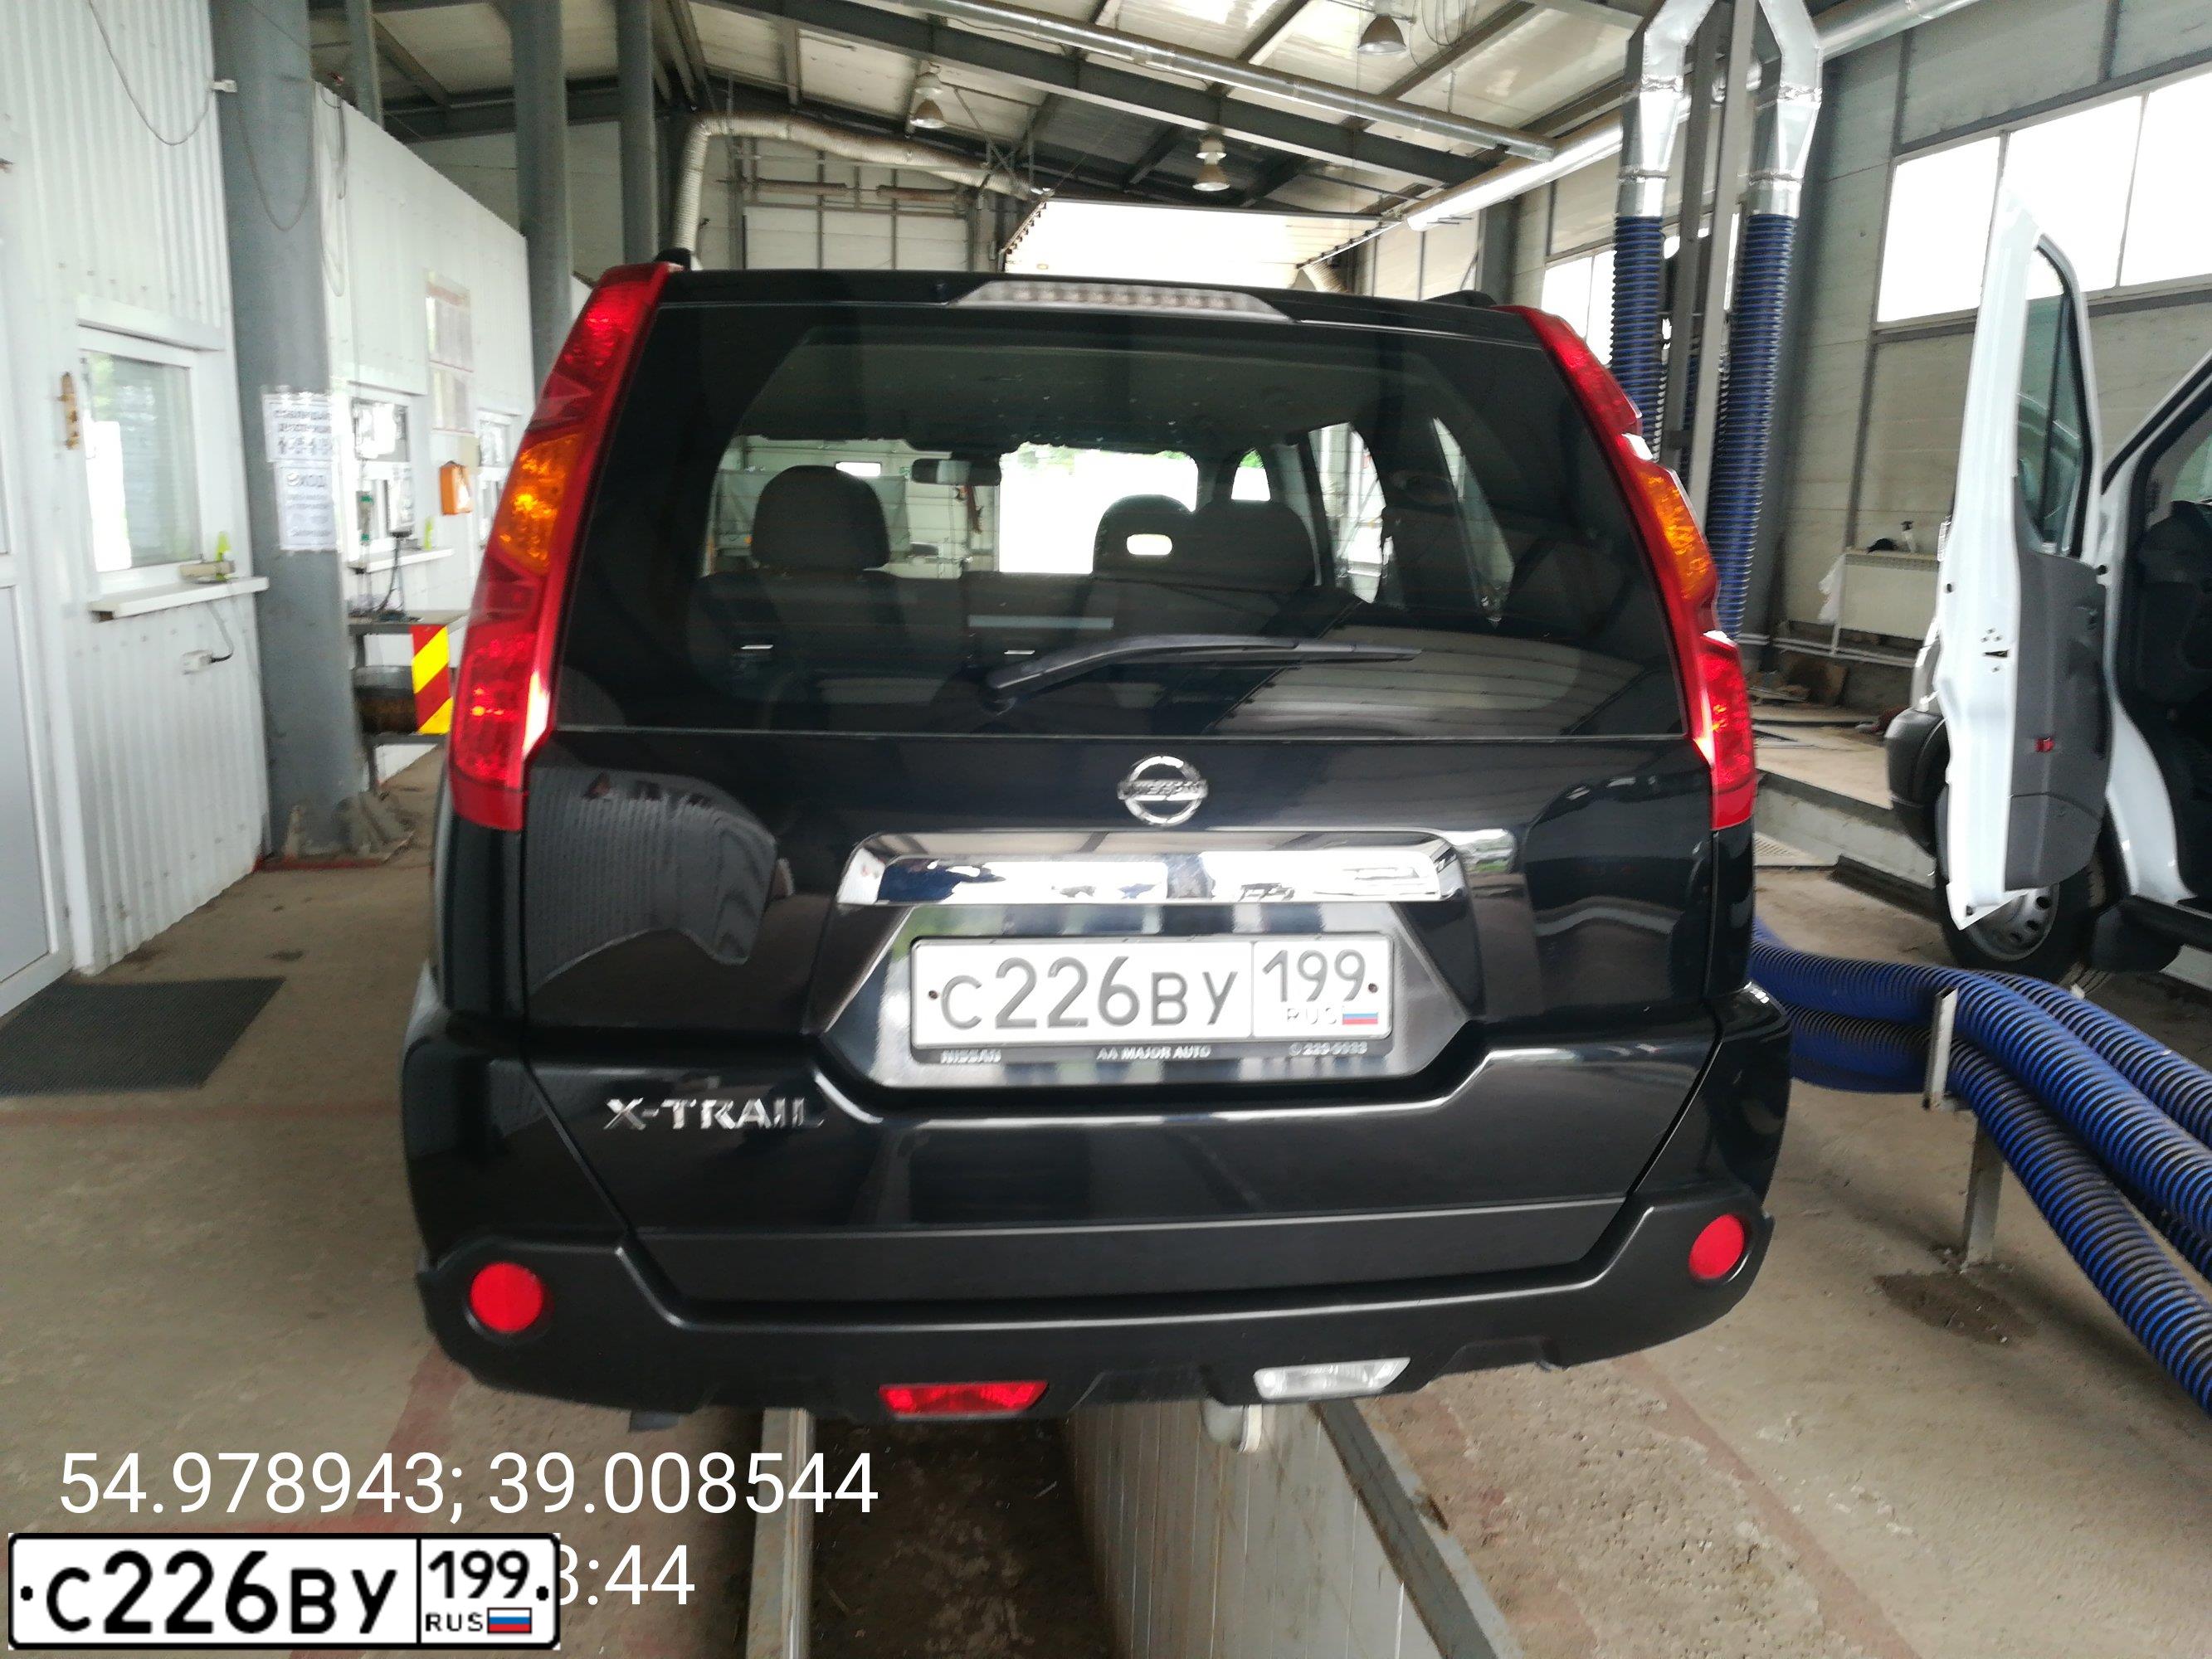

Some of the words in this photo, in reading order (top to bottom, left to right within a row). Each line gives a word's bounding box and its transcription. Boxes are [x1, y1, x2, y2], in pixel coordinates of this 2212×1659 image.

[1262, 948, 1367, 1003] 199
[1287, 1006, 1337, 1025] RUS
[1120, 1045, 1172, 1060] MAJOR
[1172, 1044, 1212, 1058] AUTO
[603, 1097, 825, 1130] X-TRAIL
